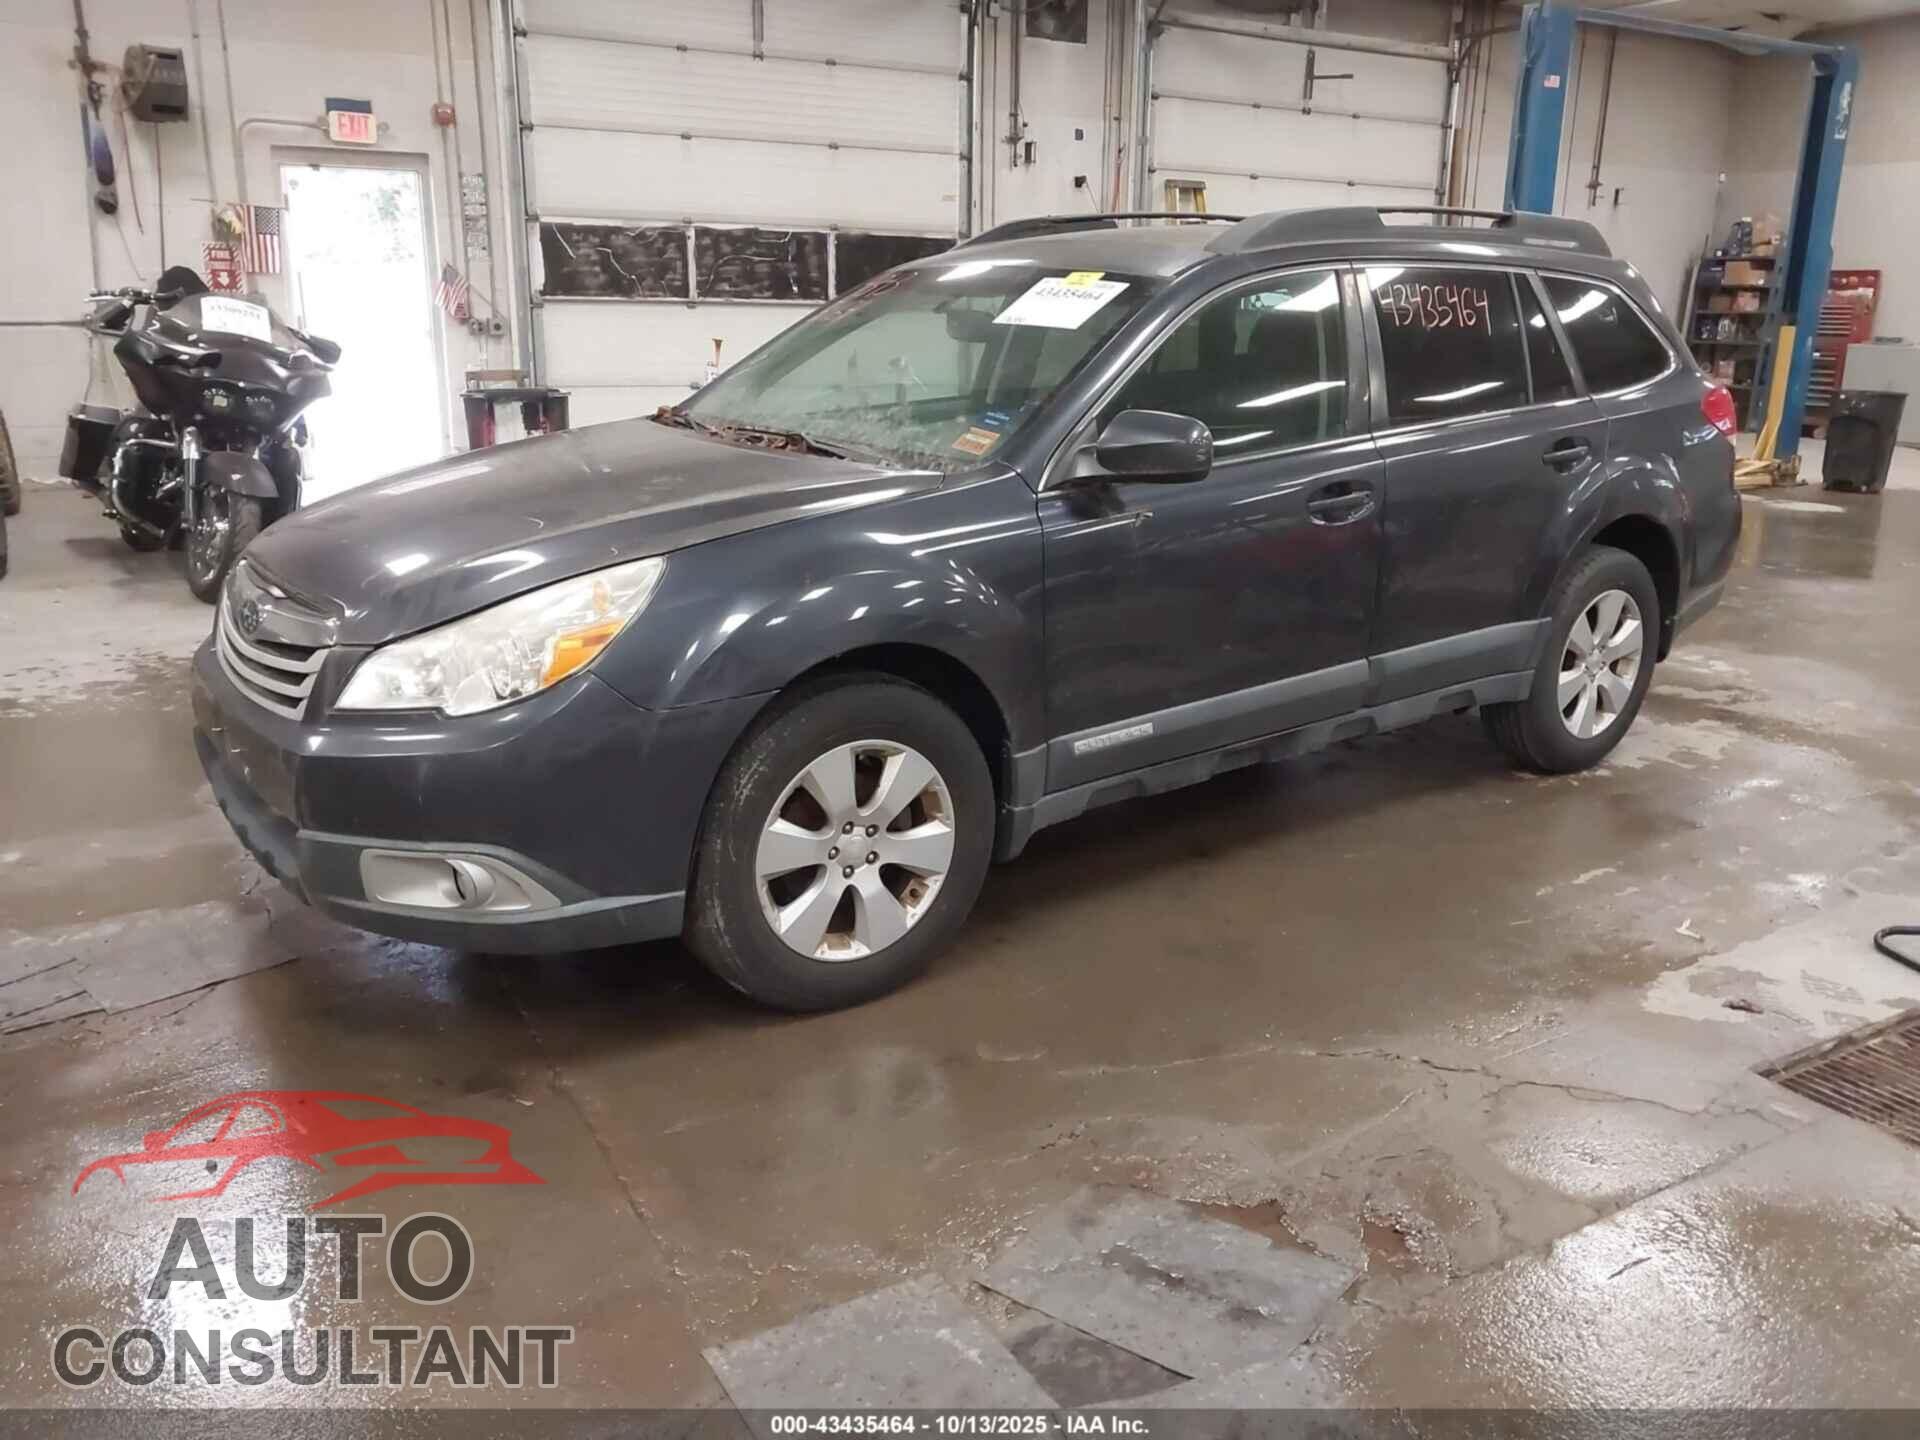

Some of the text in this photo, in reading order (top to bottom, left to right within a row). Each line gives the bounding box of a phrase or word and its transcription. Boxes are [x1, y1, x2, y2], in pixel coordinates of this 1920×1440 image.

[337, 113, 368, 140] EXIT
[1034, 286, 1106, 302] 43435464
[1377, 283, 1492, 337] 43435464
